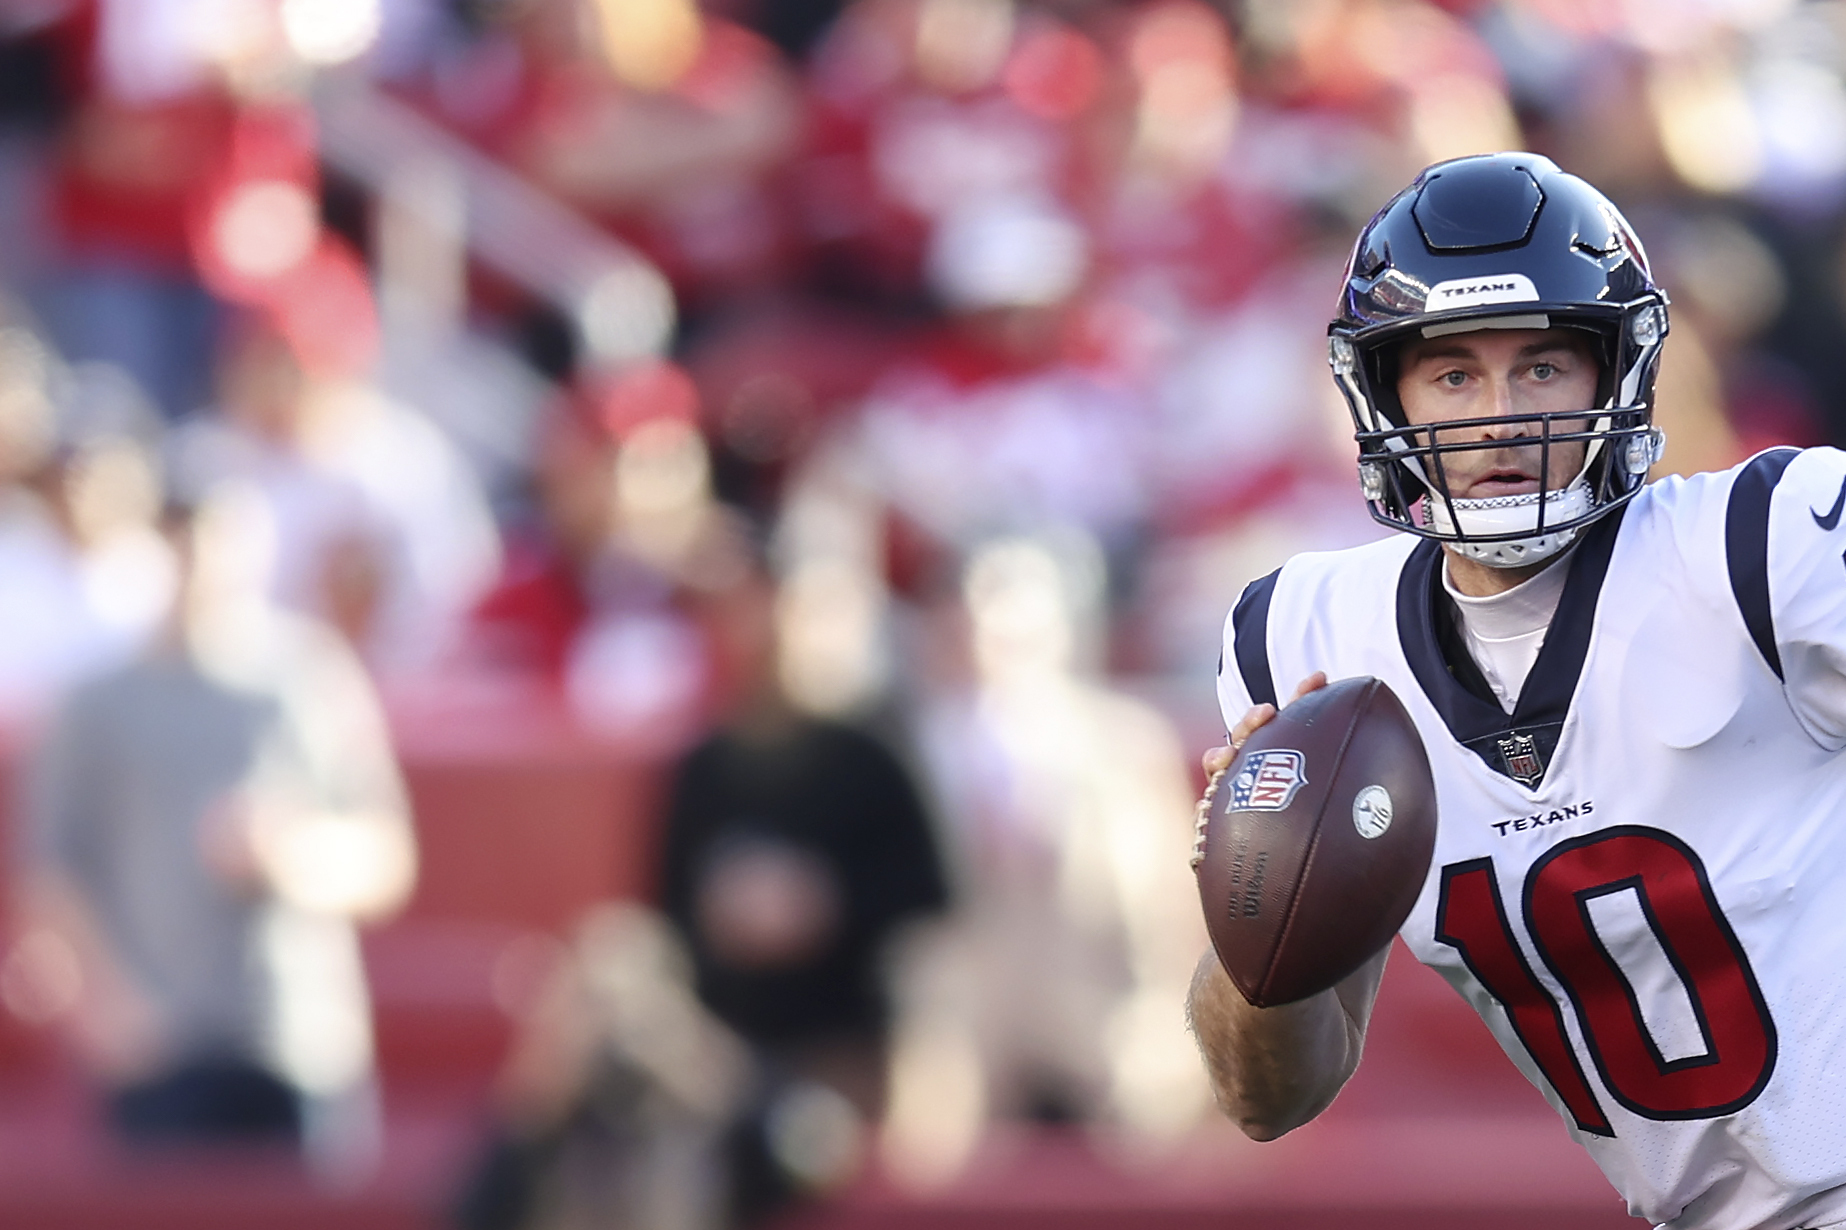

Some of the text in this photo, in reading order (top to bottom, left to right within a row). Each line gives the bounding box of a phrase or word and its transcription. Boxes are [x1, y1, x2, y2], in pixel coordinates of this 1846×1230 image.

[1442, 284, 1516, 297] TEXANS
[1254, 756, 1296, 803] NFL
[1491, 801, 1593, 836] TEXANS
[1434, 825, 1778, 1137] 10
